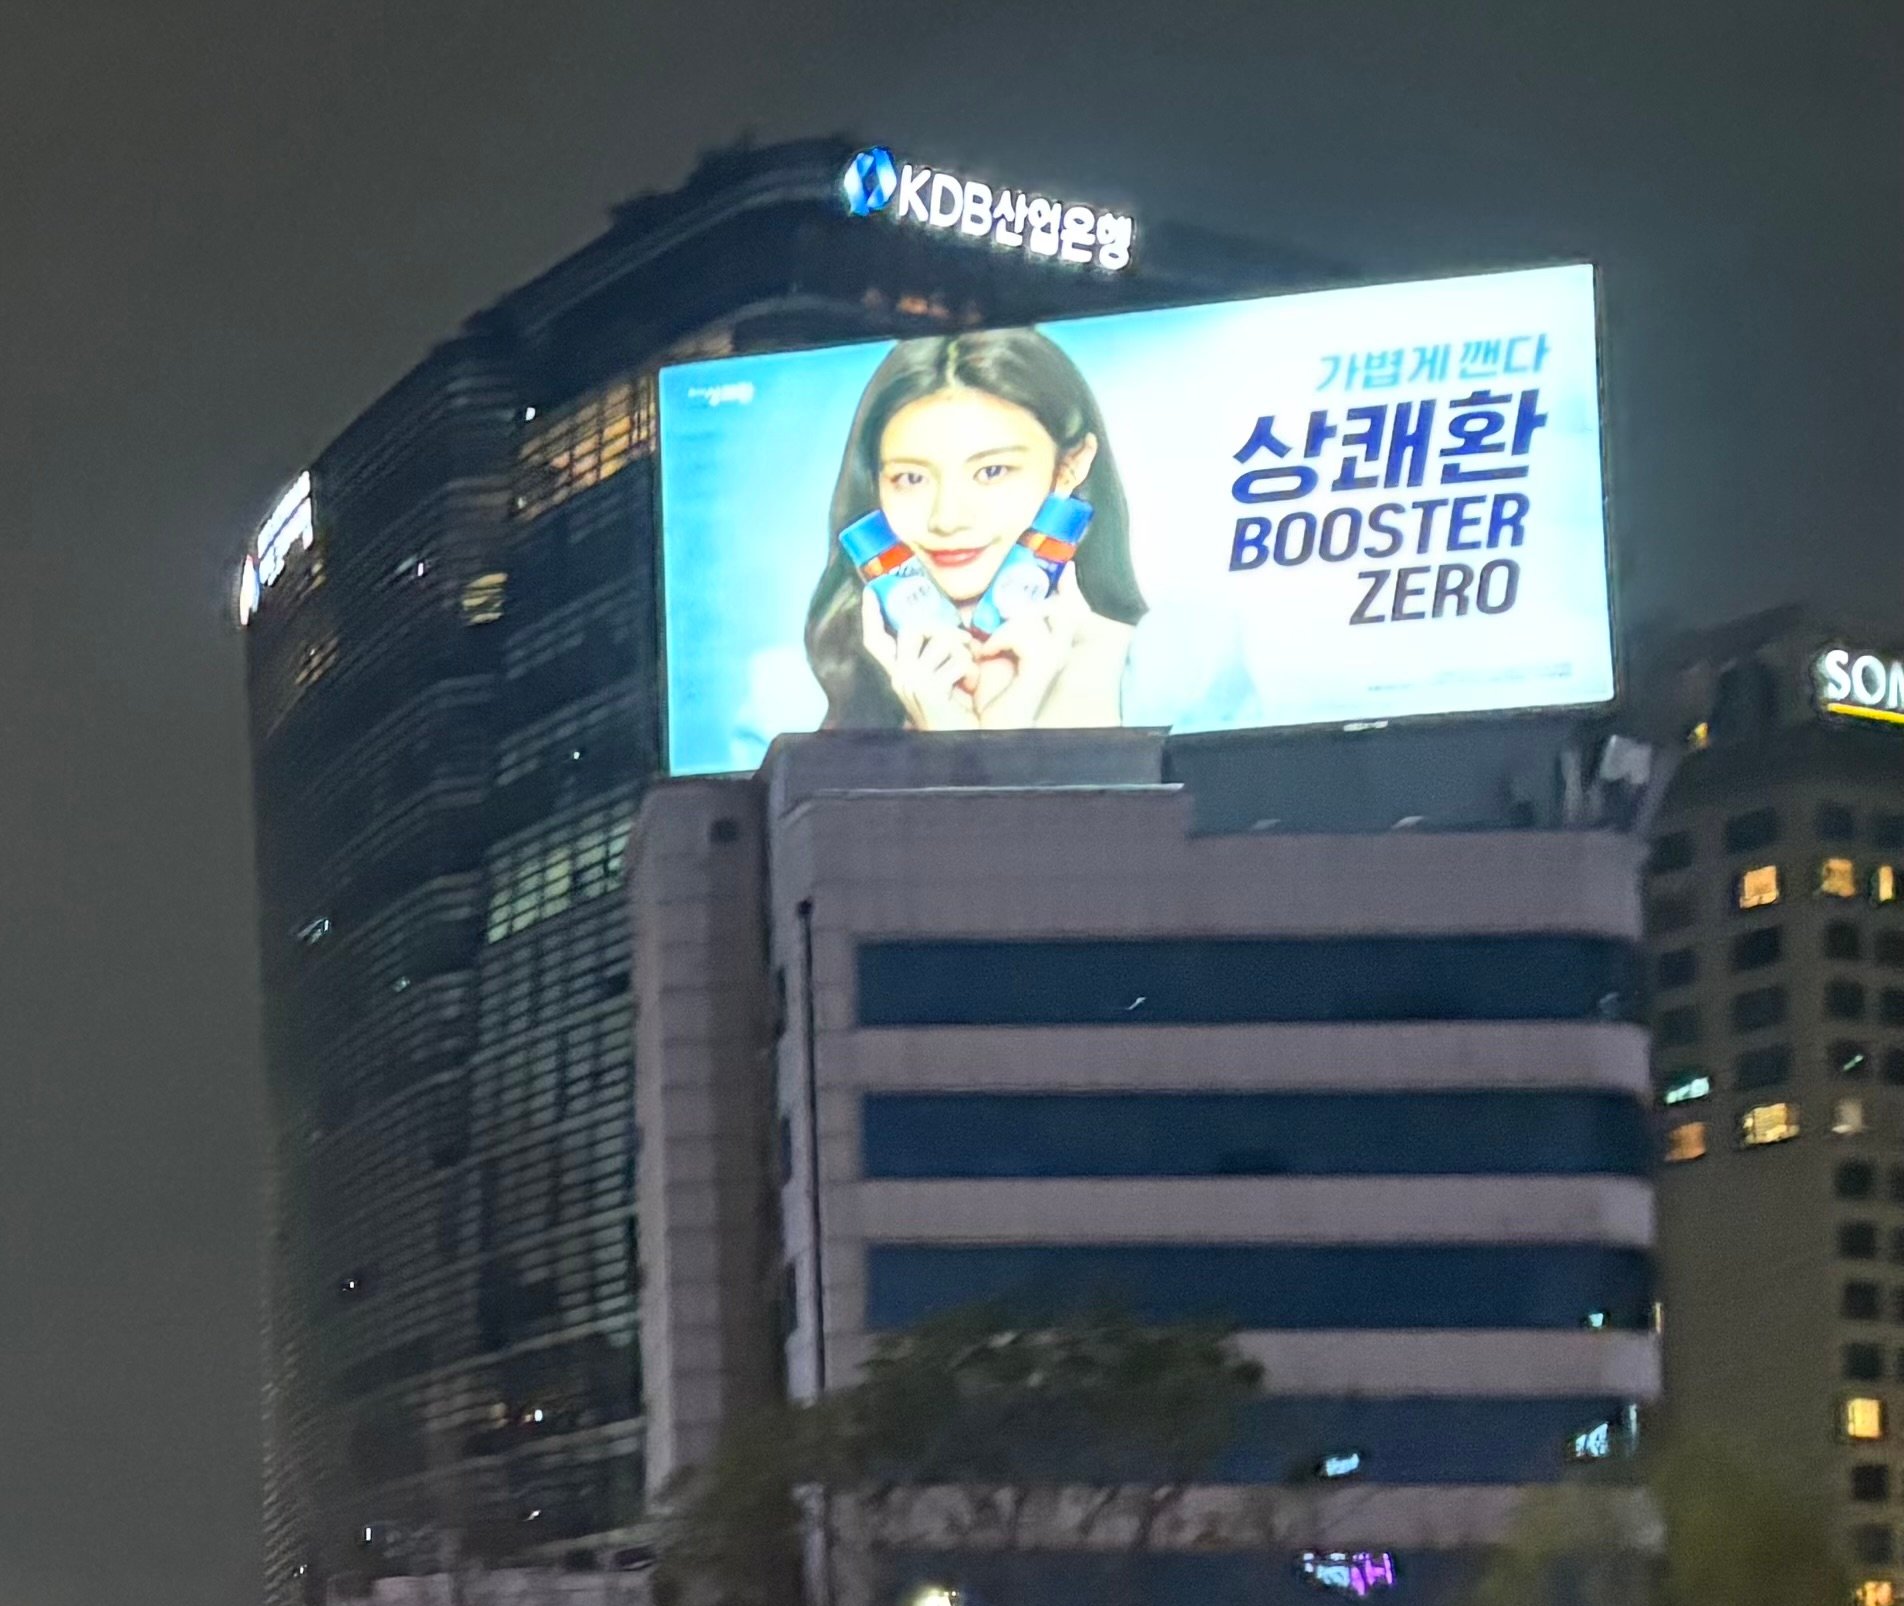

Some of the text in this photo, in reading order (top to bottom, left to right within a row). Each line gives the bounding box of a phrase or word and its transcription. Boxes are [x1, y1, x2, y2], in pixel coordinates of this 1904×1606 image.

[899, 163, 1133, 271] KDB산업은행
[1315, 332, 1552, 393] 가볍게 깬다
[1230, 388, 1549, 505] 상쾌환
[1228, 492, 1531, 573] BOOSTER
[1348, 557, 1522, 627] ZERO
